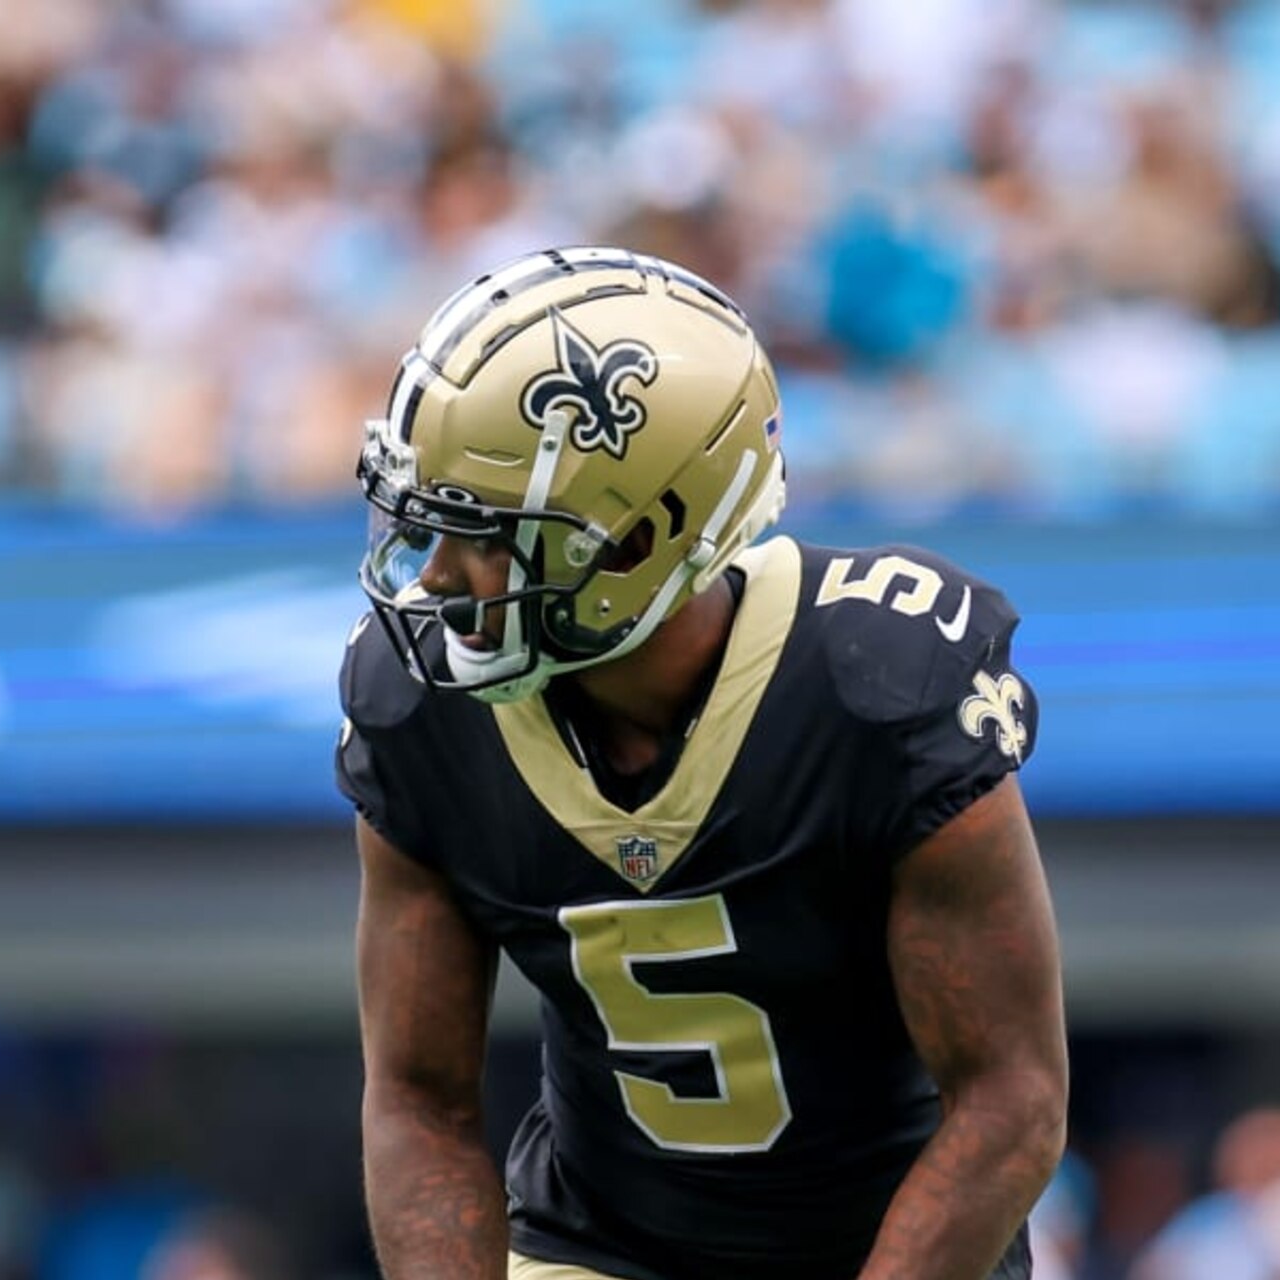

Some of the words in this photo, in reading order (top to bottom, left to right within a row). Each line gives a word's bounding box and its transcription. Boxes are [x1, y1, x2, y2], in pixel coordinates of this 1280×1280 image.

[815, 555, 944, 616] 5
[625, 857, 656, 878] NFL
[558, 893, 793, 1154] 5
